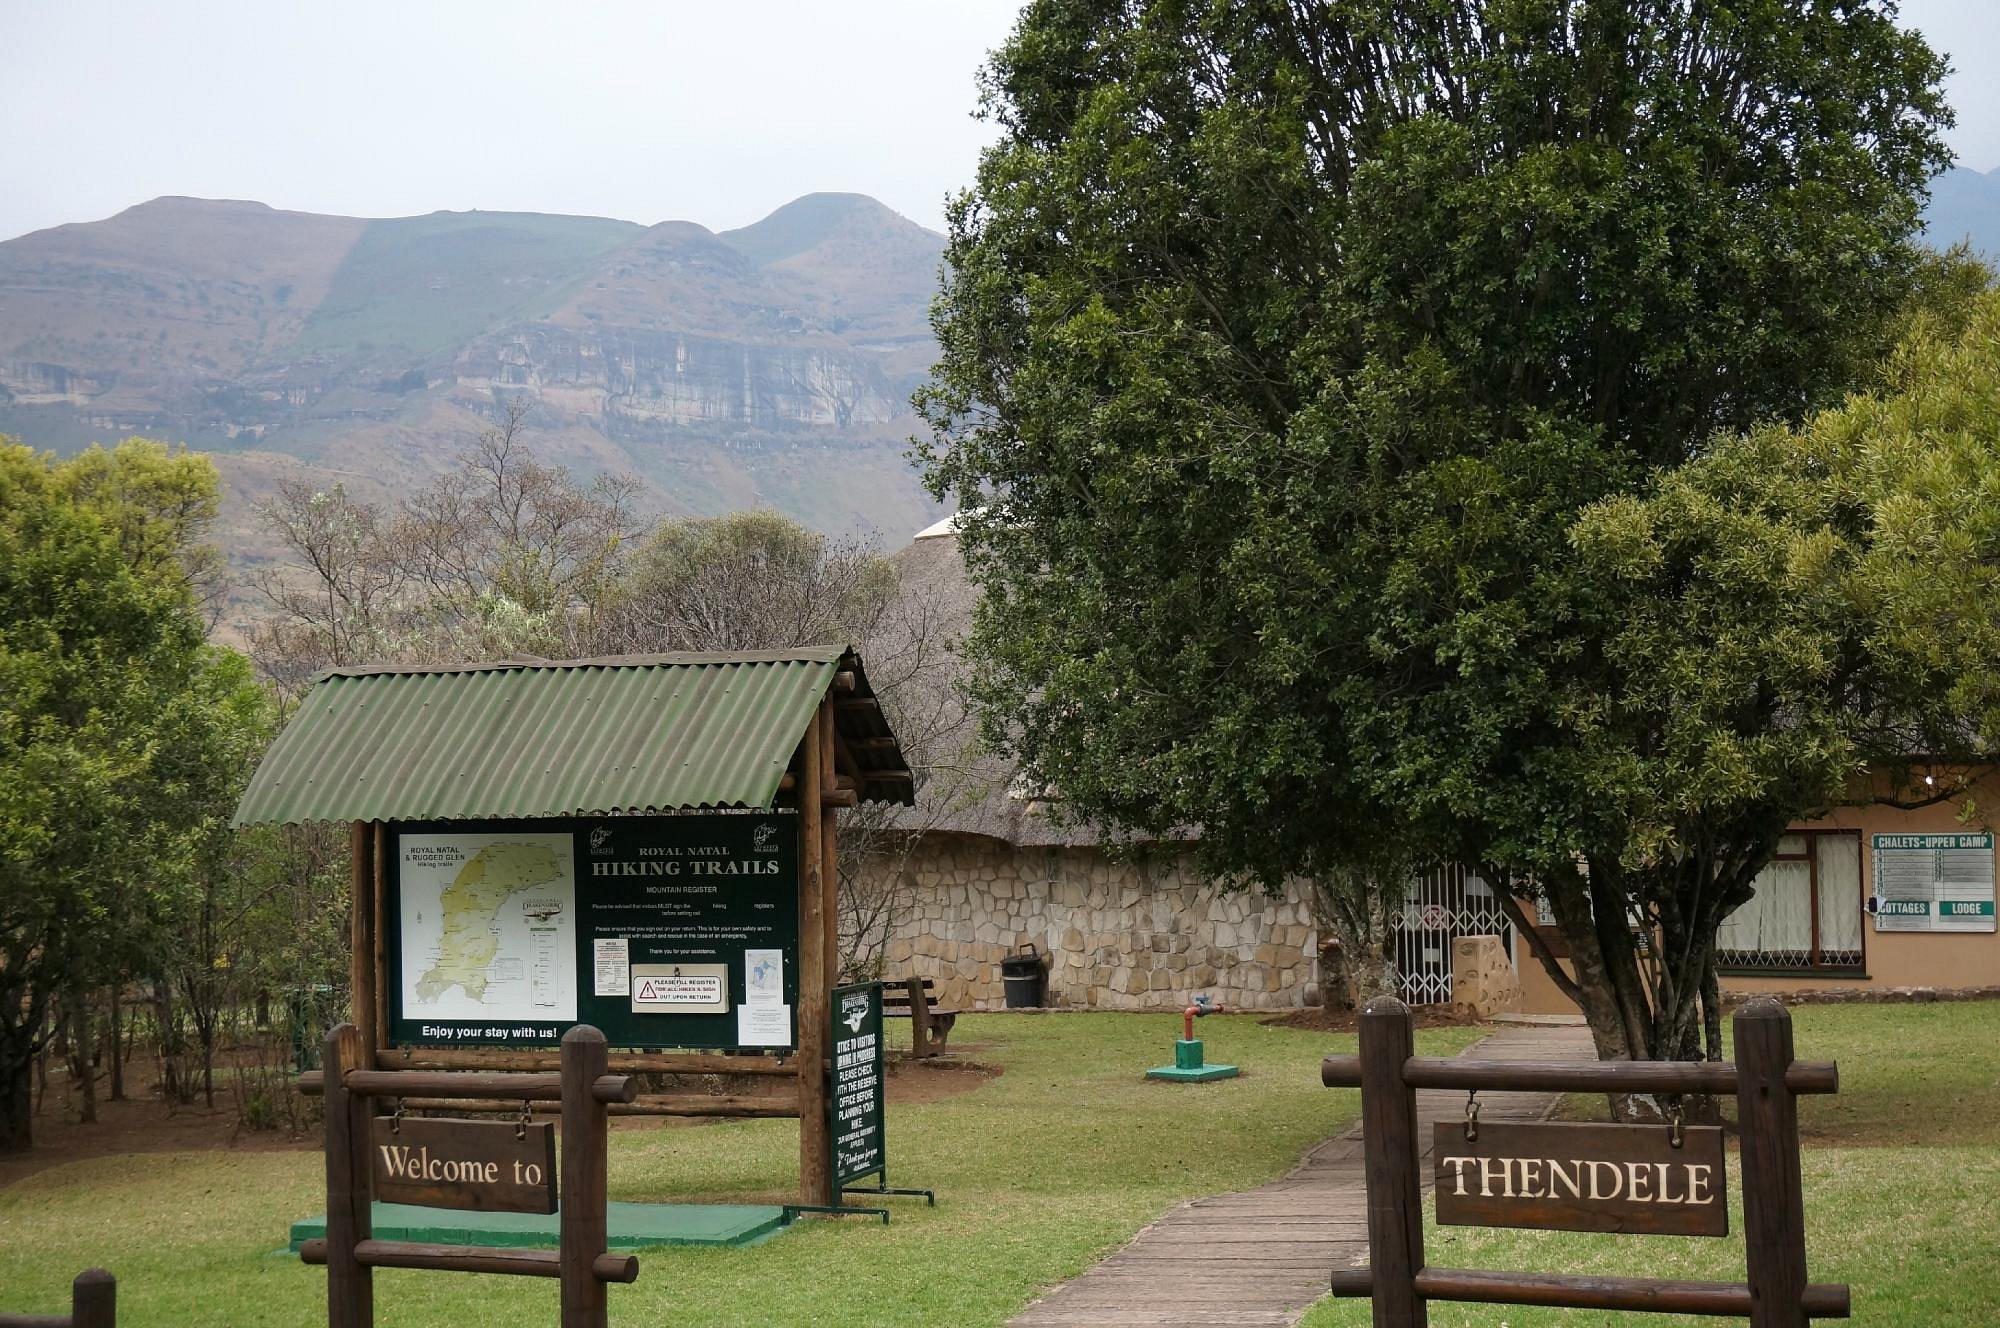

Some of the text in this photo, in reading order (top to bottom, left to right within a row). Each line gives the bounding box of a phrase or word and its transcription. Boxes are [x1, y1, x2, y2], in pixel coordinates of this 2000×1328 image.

[1959, 836, 1988, 848] CAMP
[639, 847, 730, 856] ROYAL NATAL
[592, 860, 780, 876] HIKING TRAILS
[1952, 903, 1982, 914] LODGE
[422, 1026, 557, 1041] Enjoy your stay with us!
[840, 1064, 872, 1082] PLEASE CHECK
[848, 1081, 857, 1093] THE
[858, 1075, 877, 1090] RESERVE
[839, 1089, 874, 1108] OFFICE BEFORE
[839, 1101, 874, 1120] PLANNING YOUR
[851, 1118, 863, 1129] HIKE
[379, 1144, 542, 1186] Welcome to
[1442, 1156, 1714, 1205] THENDELE
